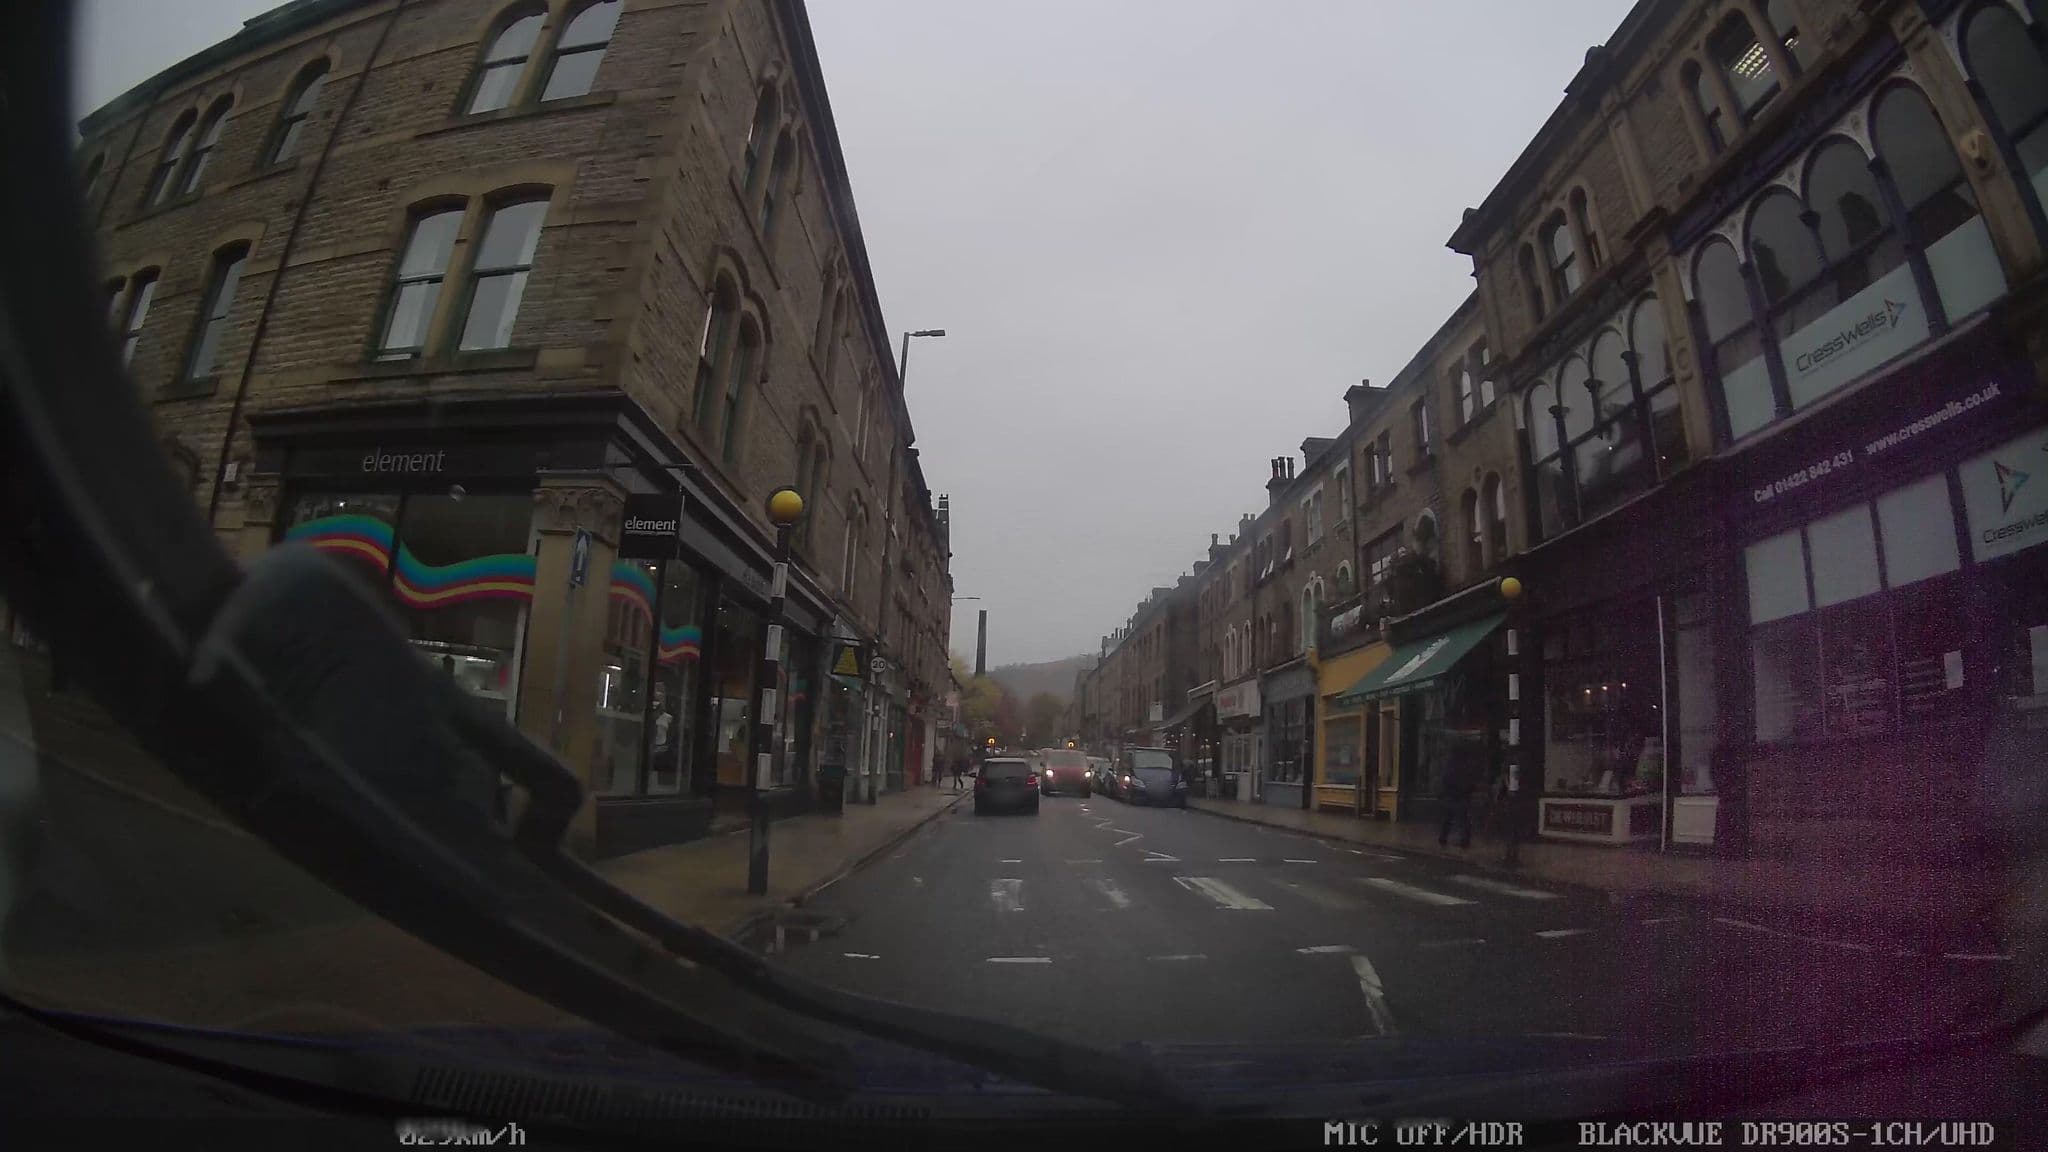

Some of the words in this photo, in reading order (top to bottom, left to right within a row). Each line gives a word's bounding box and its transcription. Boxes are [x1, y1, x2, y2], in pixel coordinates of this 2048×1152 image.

[1753, 484, 1774, 503] Call
[1775, 470, 1808, 493] 01422
[1809, 459, 1832, 480] 842
[1832, 449, 1854, 468] 431
[1865, 381, 2002, 456] www.cresswells.co.uk
[362, 448, 446, 472] element
[624, 515, 677, 531] element
[872, 660, 885, 669] 20
